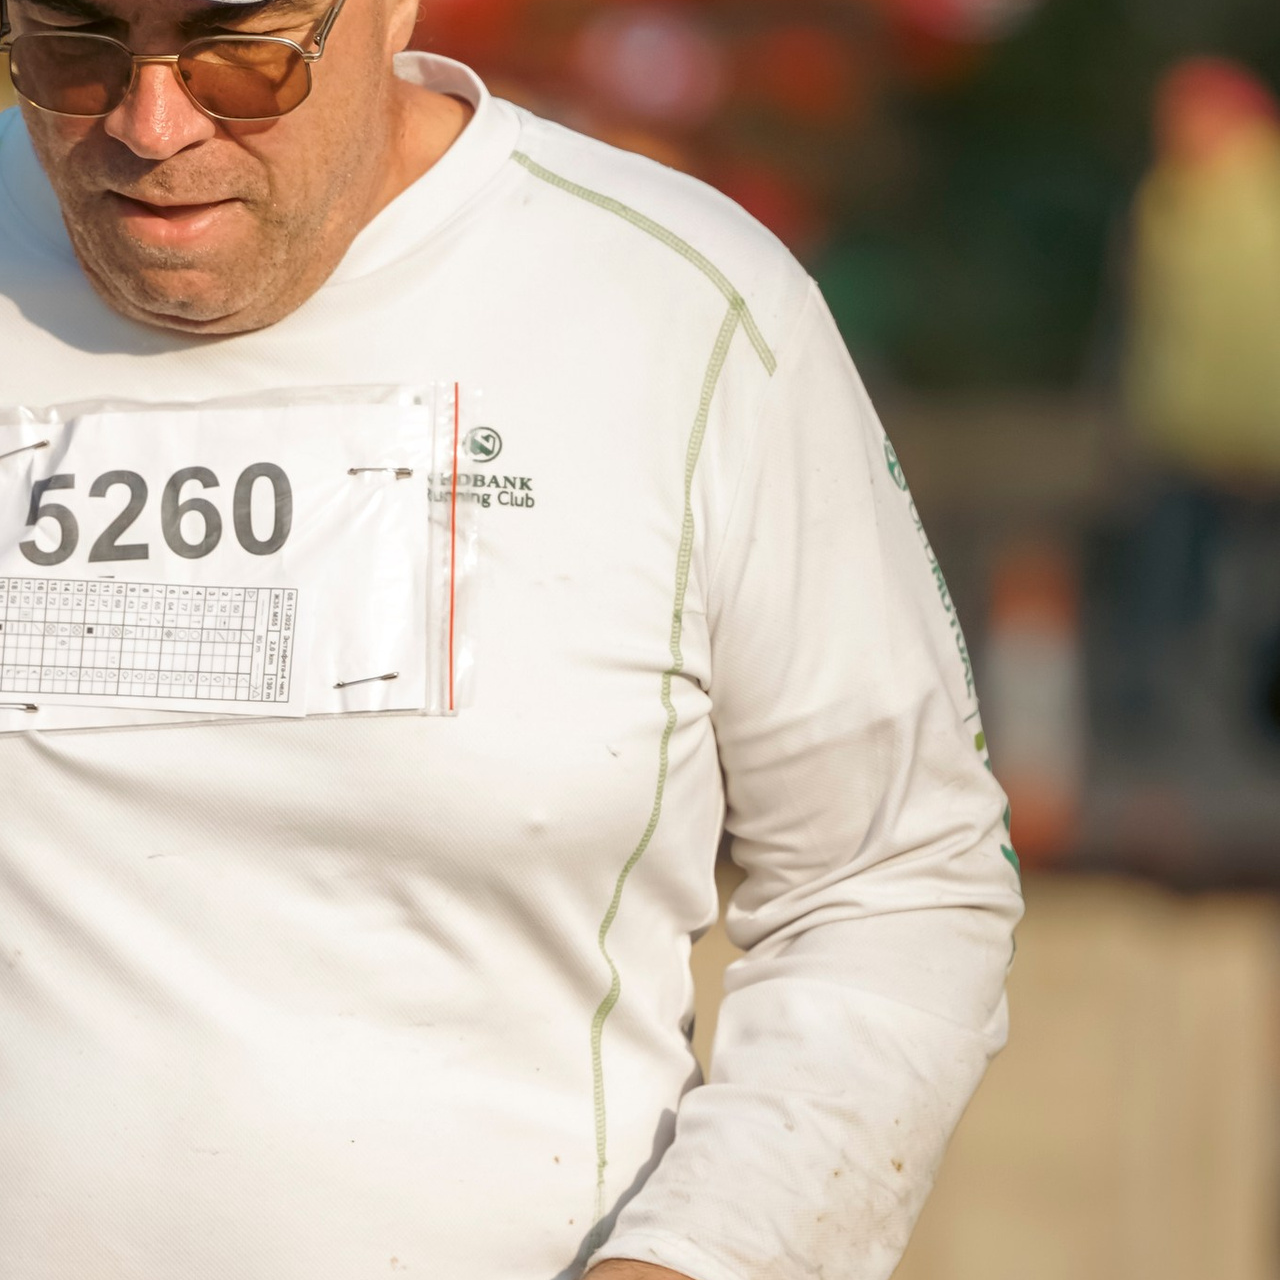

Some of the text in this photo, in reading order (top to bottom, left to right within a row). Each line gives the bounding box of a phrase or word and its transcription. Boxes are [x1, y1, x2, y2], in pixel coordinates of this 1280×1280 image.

[497, 490, 535, 508] Club
[19, 461, 294, 566] 5260
[89, 583, 97, 593] 12
[264, 676, 273, 699] 130 m
